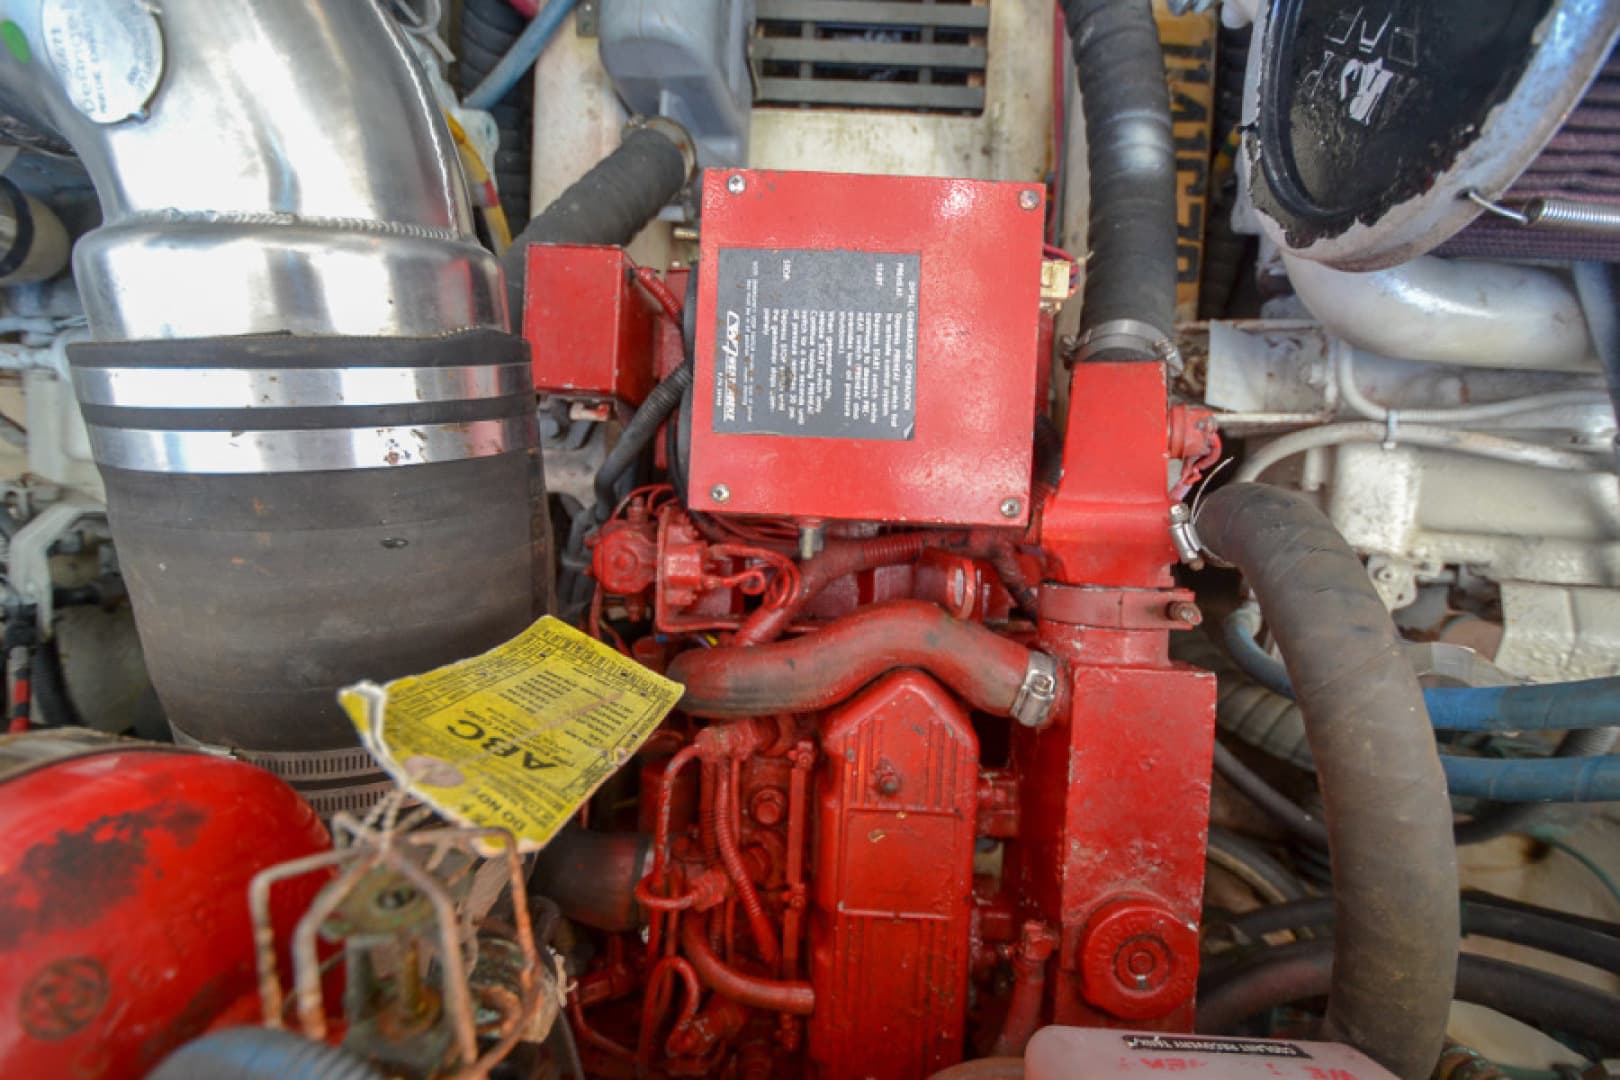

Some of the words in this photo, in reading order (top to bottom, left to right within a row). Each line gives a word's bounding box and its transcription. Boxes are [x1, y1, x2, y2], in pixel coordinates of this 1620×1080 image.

[906, 311, 914, 360] GENERATOR
[725, 355, 737, 422] WESTBEKE
[892, 349, 901, 381] PREHEAT
[904, 363, 913, 410] OPERATION
[447, 718, 557, 771] ABC
[502, 810, 526, 832] DO
